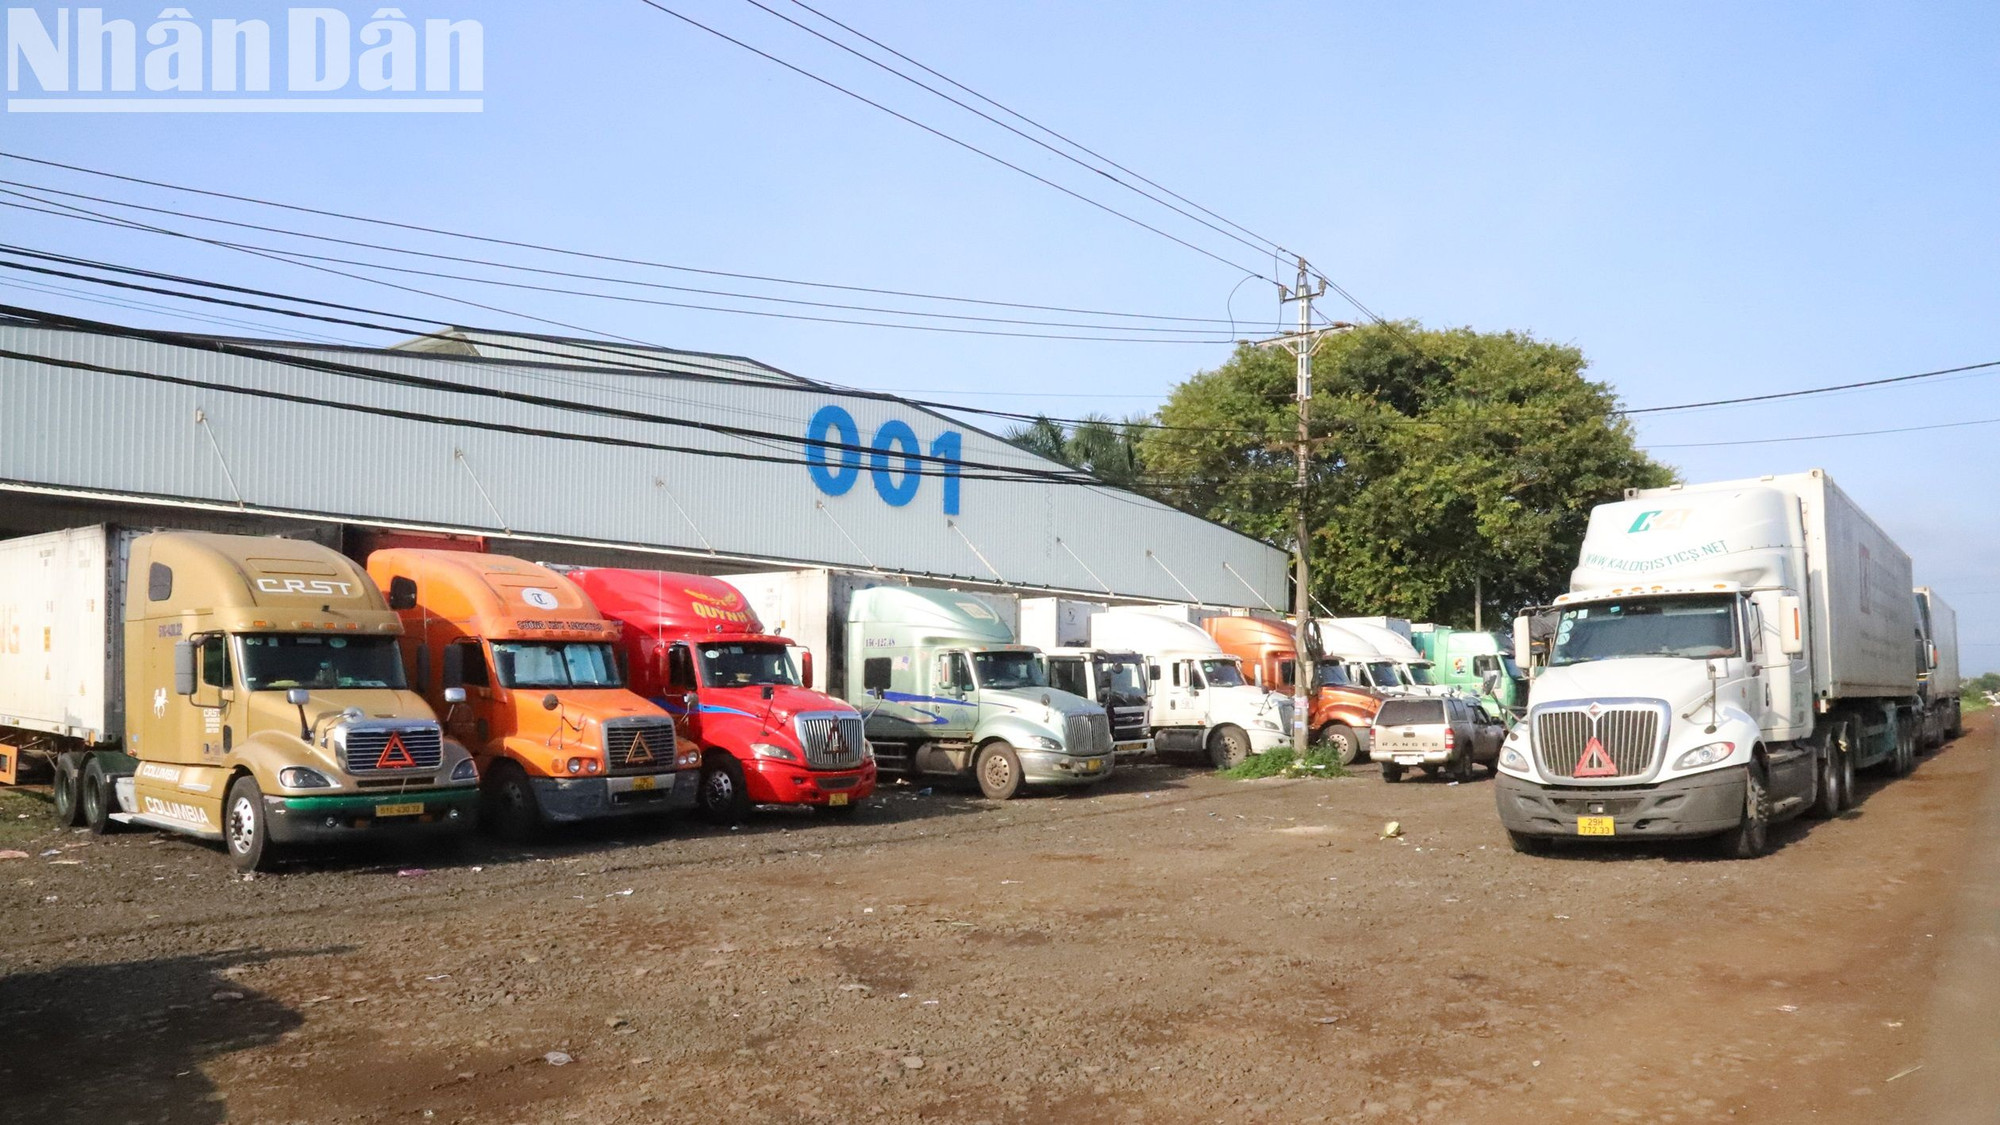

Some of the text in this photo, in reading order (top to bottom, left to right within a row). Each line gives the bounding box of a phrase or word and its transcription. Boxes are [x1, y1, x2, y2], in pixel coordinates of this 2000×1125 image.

[805, 405, 962, 516] 001
[257, 579, 351, 595] CRST
[142, 764, 180, 782] COLUMBIA
[144, 796, 210, 824] COLUMBIA
